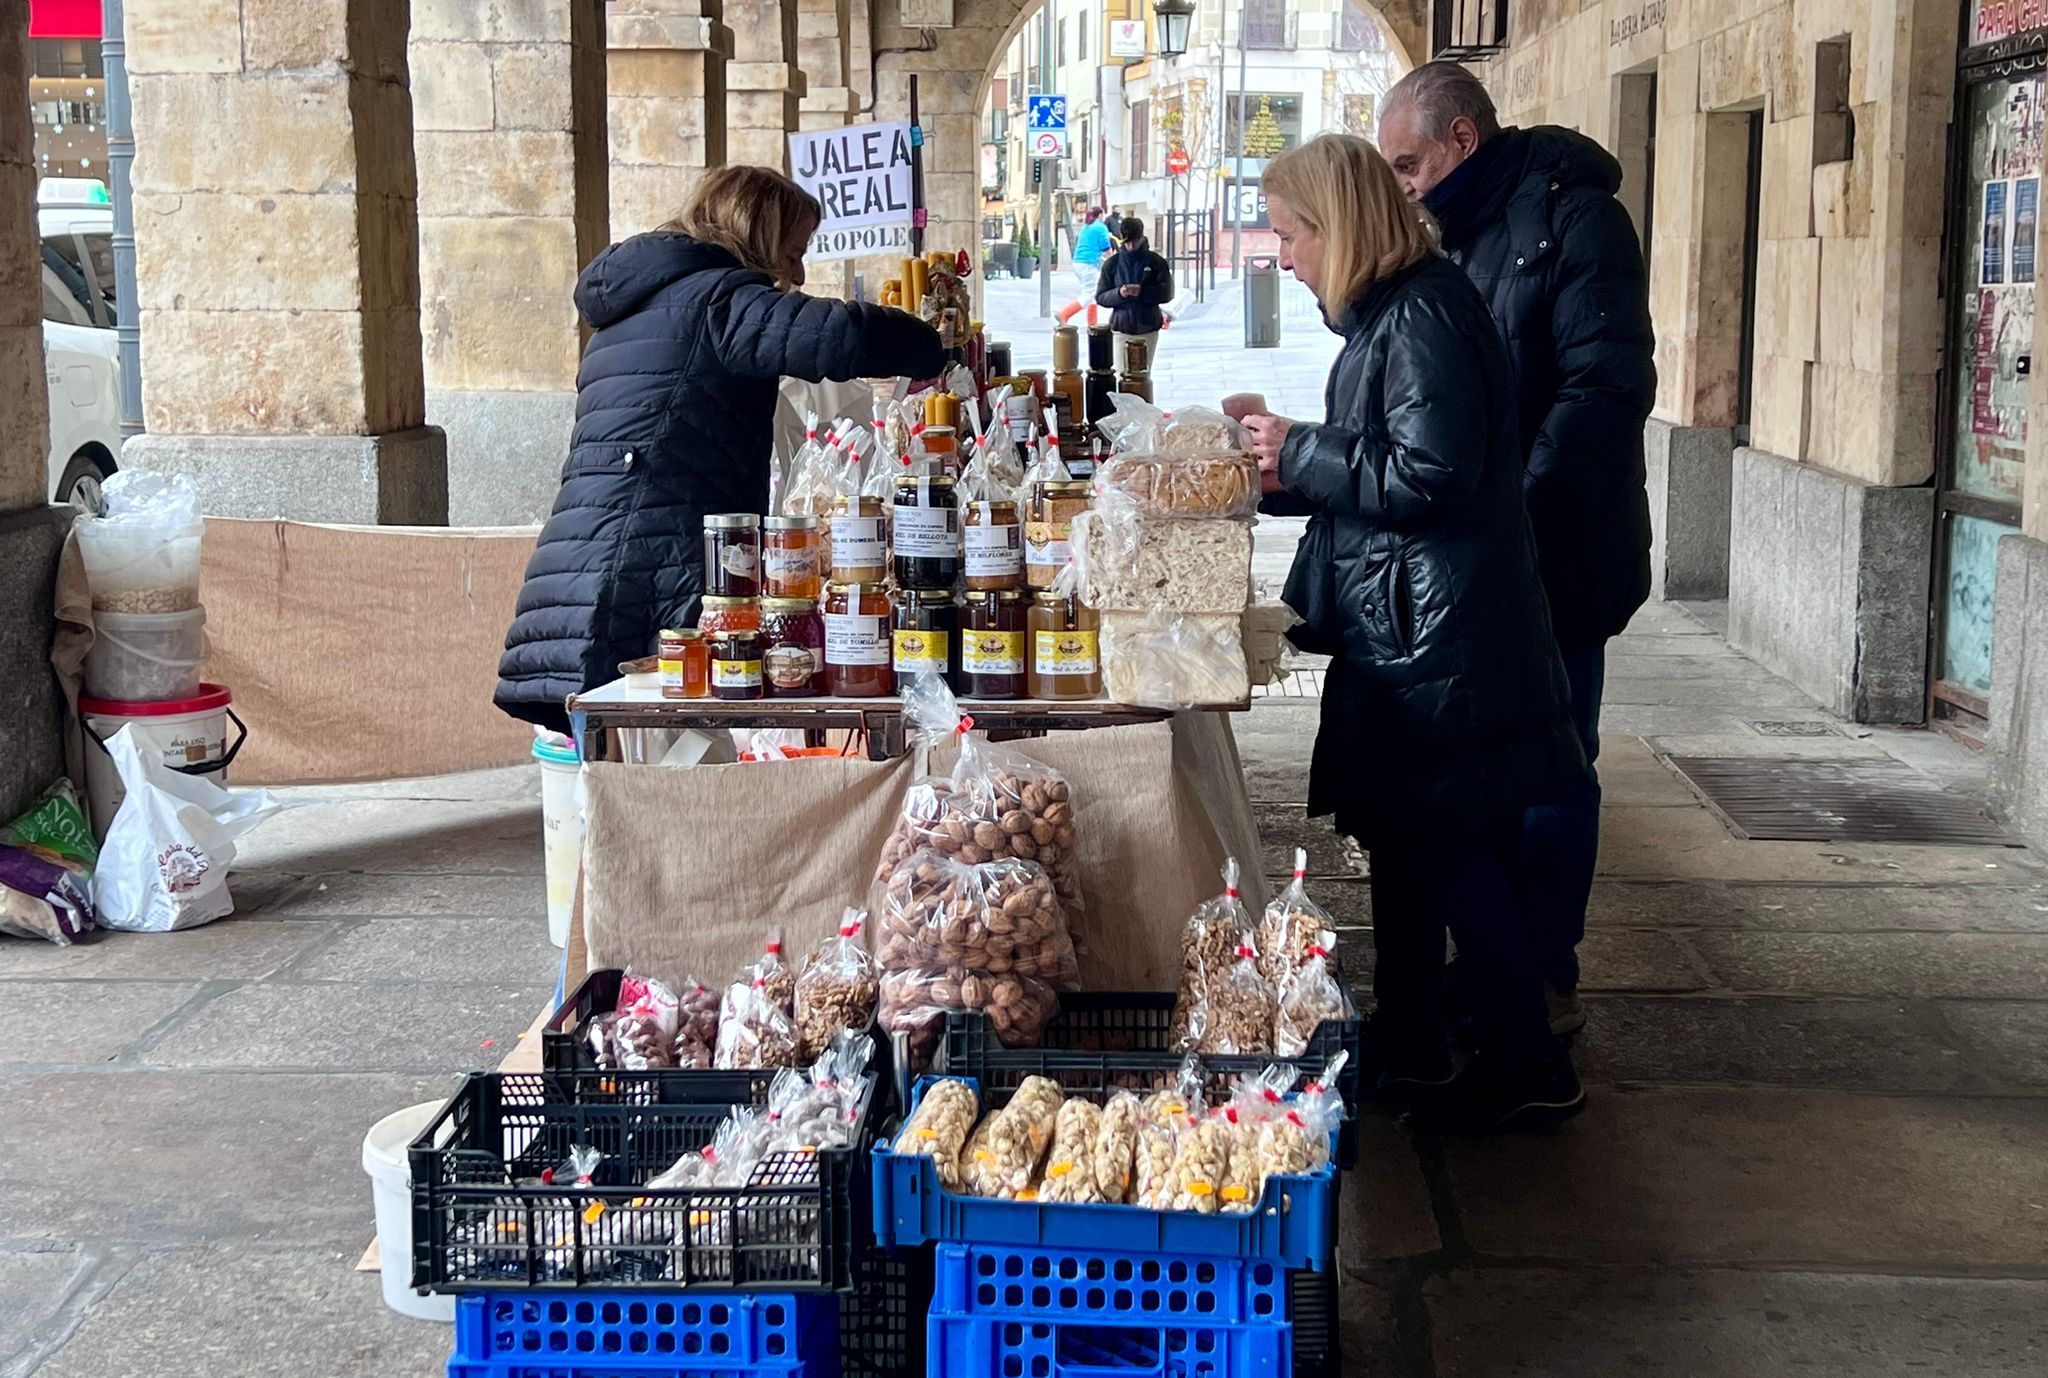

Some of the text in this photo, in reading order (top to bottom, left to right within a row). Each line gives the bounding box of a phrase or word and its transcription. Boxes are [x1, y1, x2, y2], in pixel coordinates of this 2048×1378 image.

[1977, 0, 2016, 41] PARA
[799, 129, 912, 178] JALEA
[819, 174, 908, 220] REAL
[158, 844, 182, 868] Casa
[185, 846, 204, 859] del
